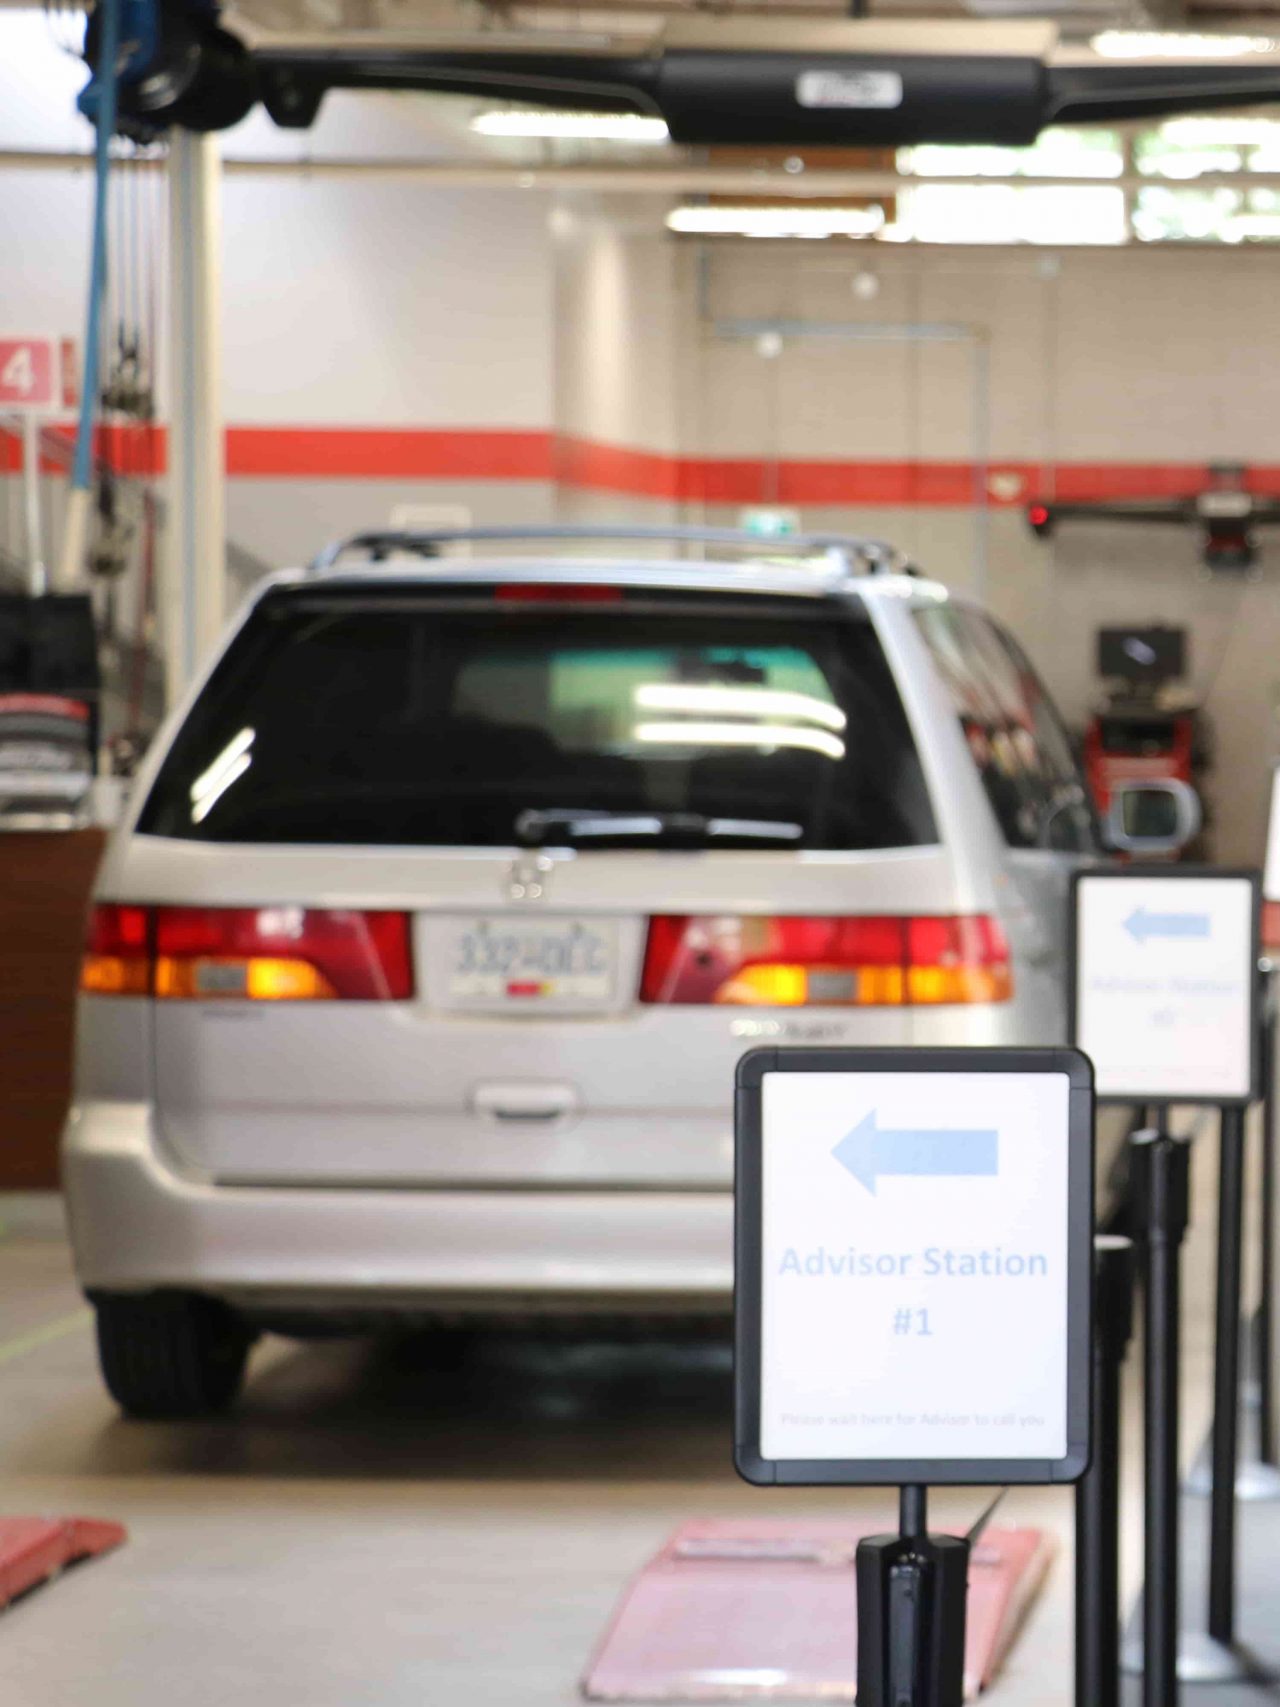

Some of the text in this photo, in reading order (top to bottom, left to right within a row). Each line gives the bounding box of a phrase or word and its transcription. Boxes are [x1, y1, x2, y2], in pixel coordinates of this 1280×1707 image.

[2, 346, 37, 397] 4
[778, 1246, 1048, 1276] Advisor Station
[892, 1307, 933, 1336] #1
[781, 1411, 1045, 1428] Please wait here for Advisor to call you
